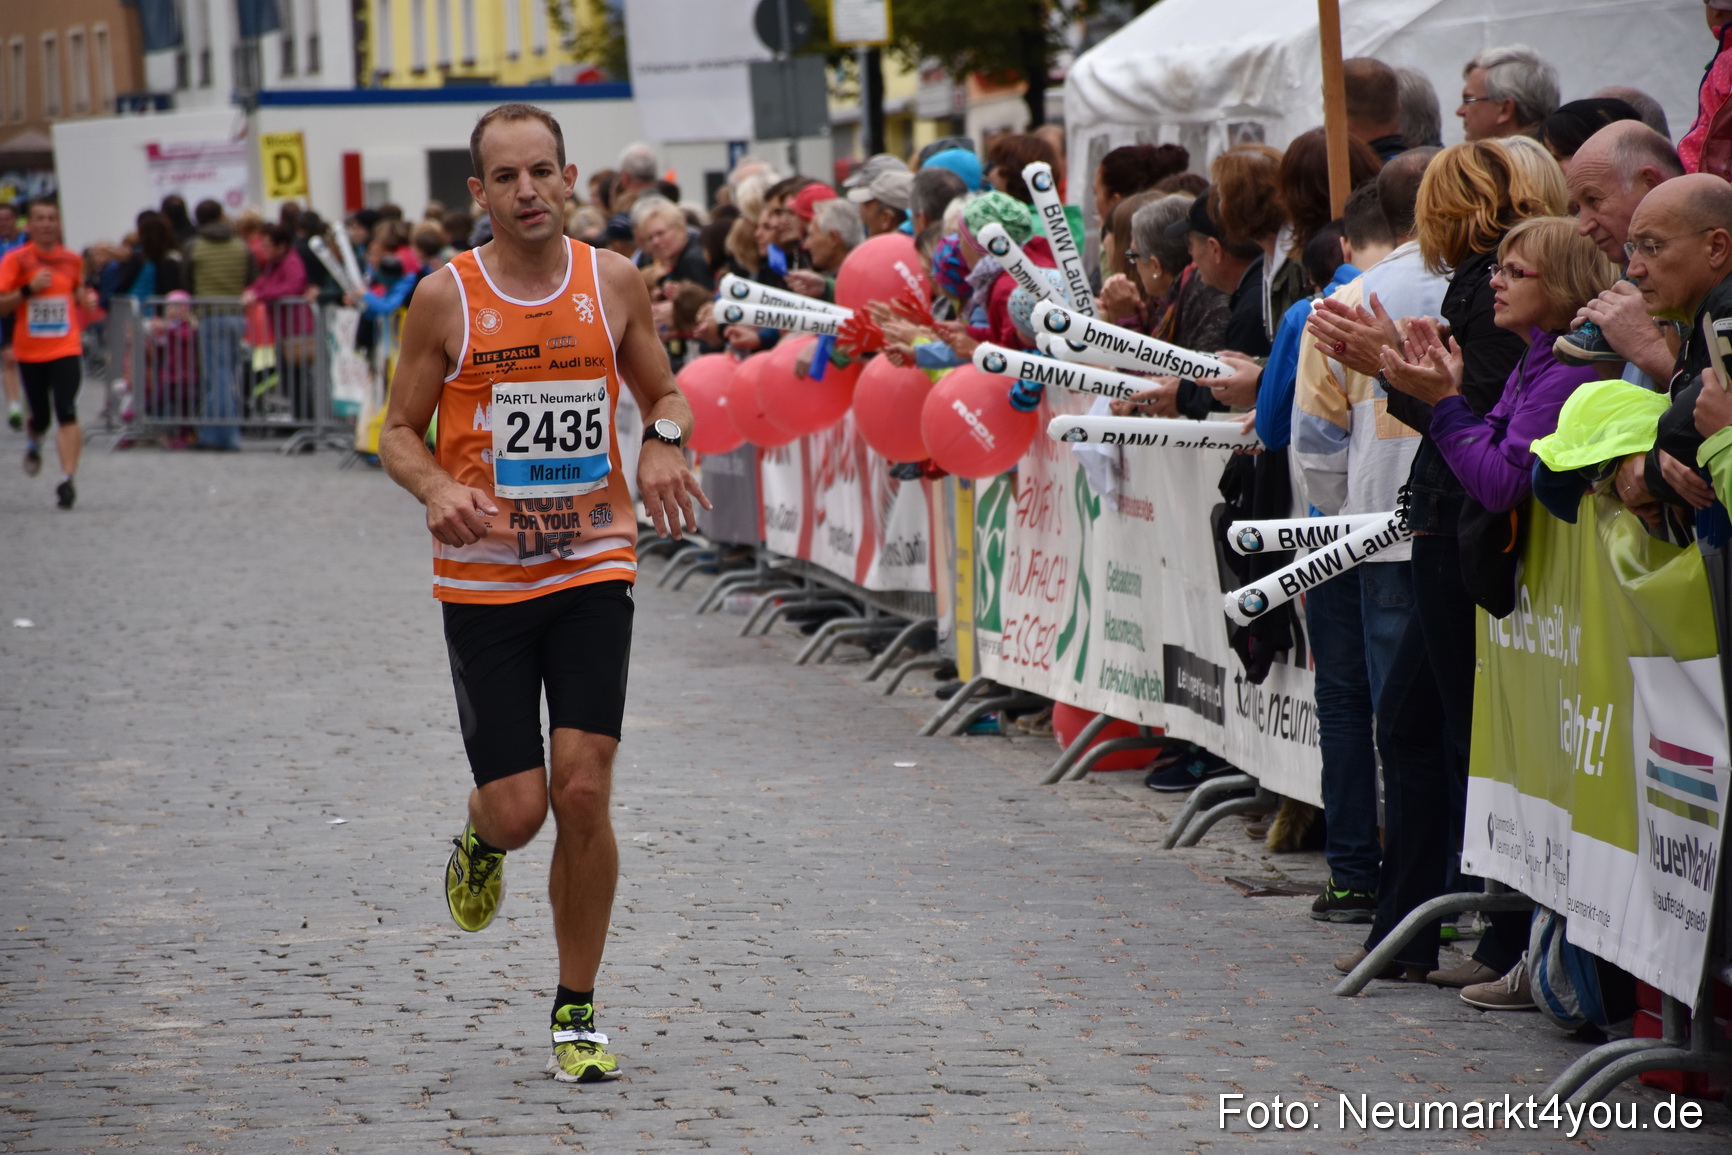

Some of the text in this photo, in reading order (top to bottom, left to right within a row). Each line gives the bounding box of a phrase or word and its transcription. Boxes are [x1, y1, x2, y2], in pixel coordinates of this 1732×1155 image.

[273, 152, 298, 184] D
[1043, 204, 1075, 251] BMW
[754, 310, 842, 337] BMW Lauf
[476, 348, 536, 362] LIFE PARK
[549, 357, 605, 370] Audi BKK
[1019, 360, 1075, 388] BMW
[495, 392, 596, 405] PARTL Neumarkt
[506, 408, 602, 453] 2435
[530, 464, 580, 481] Martin
[510, 512, 540, 530] FOR
[541, 511, 581, 530] YOUR
[1278, 525, 1339, 549] BMW
[1278, 548, 1343, 597] BMW
[1559, 679, 1613, 777] laht!
